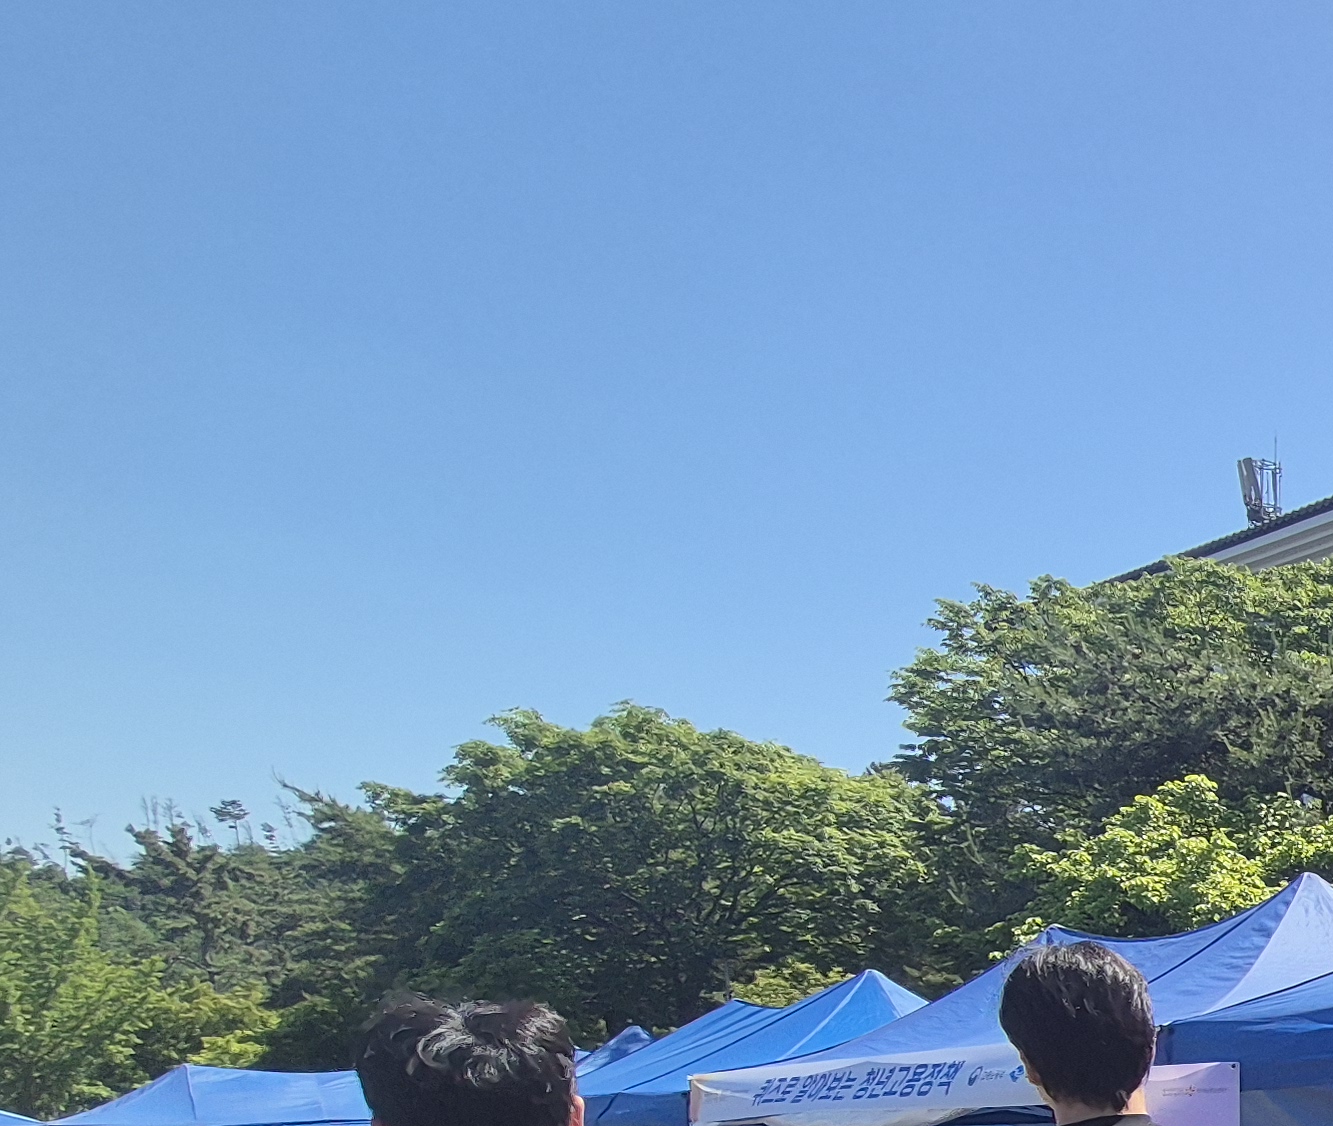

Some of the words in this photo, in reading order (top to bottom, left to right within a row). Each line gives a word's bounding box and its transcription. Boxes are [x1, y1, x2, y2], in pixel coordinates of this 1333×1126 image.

[751, 1077, 801, 1106] 퀴즈로
[797, 1070, 858, 1104] 알아보는
[852, 1060, 966, 1100] 청년고용정책
